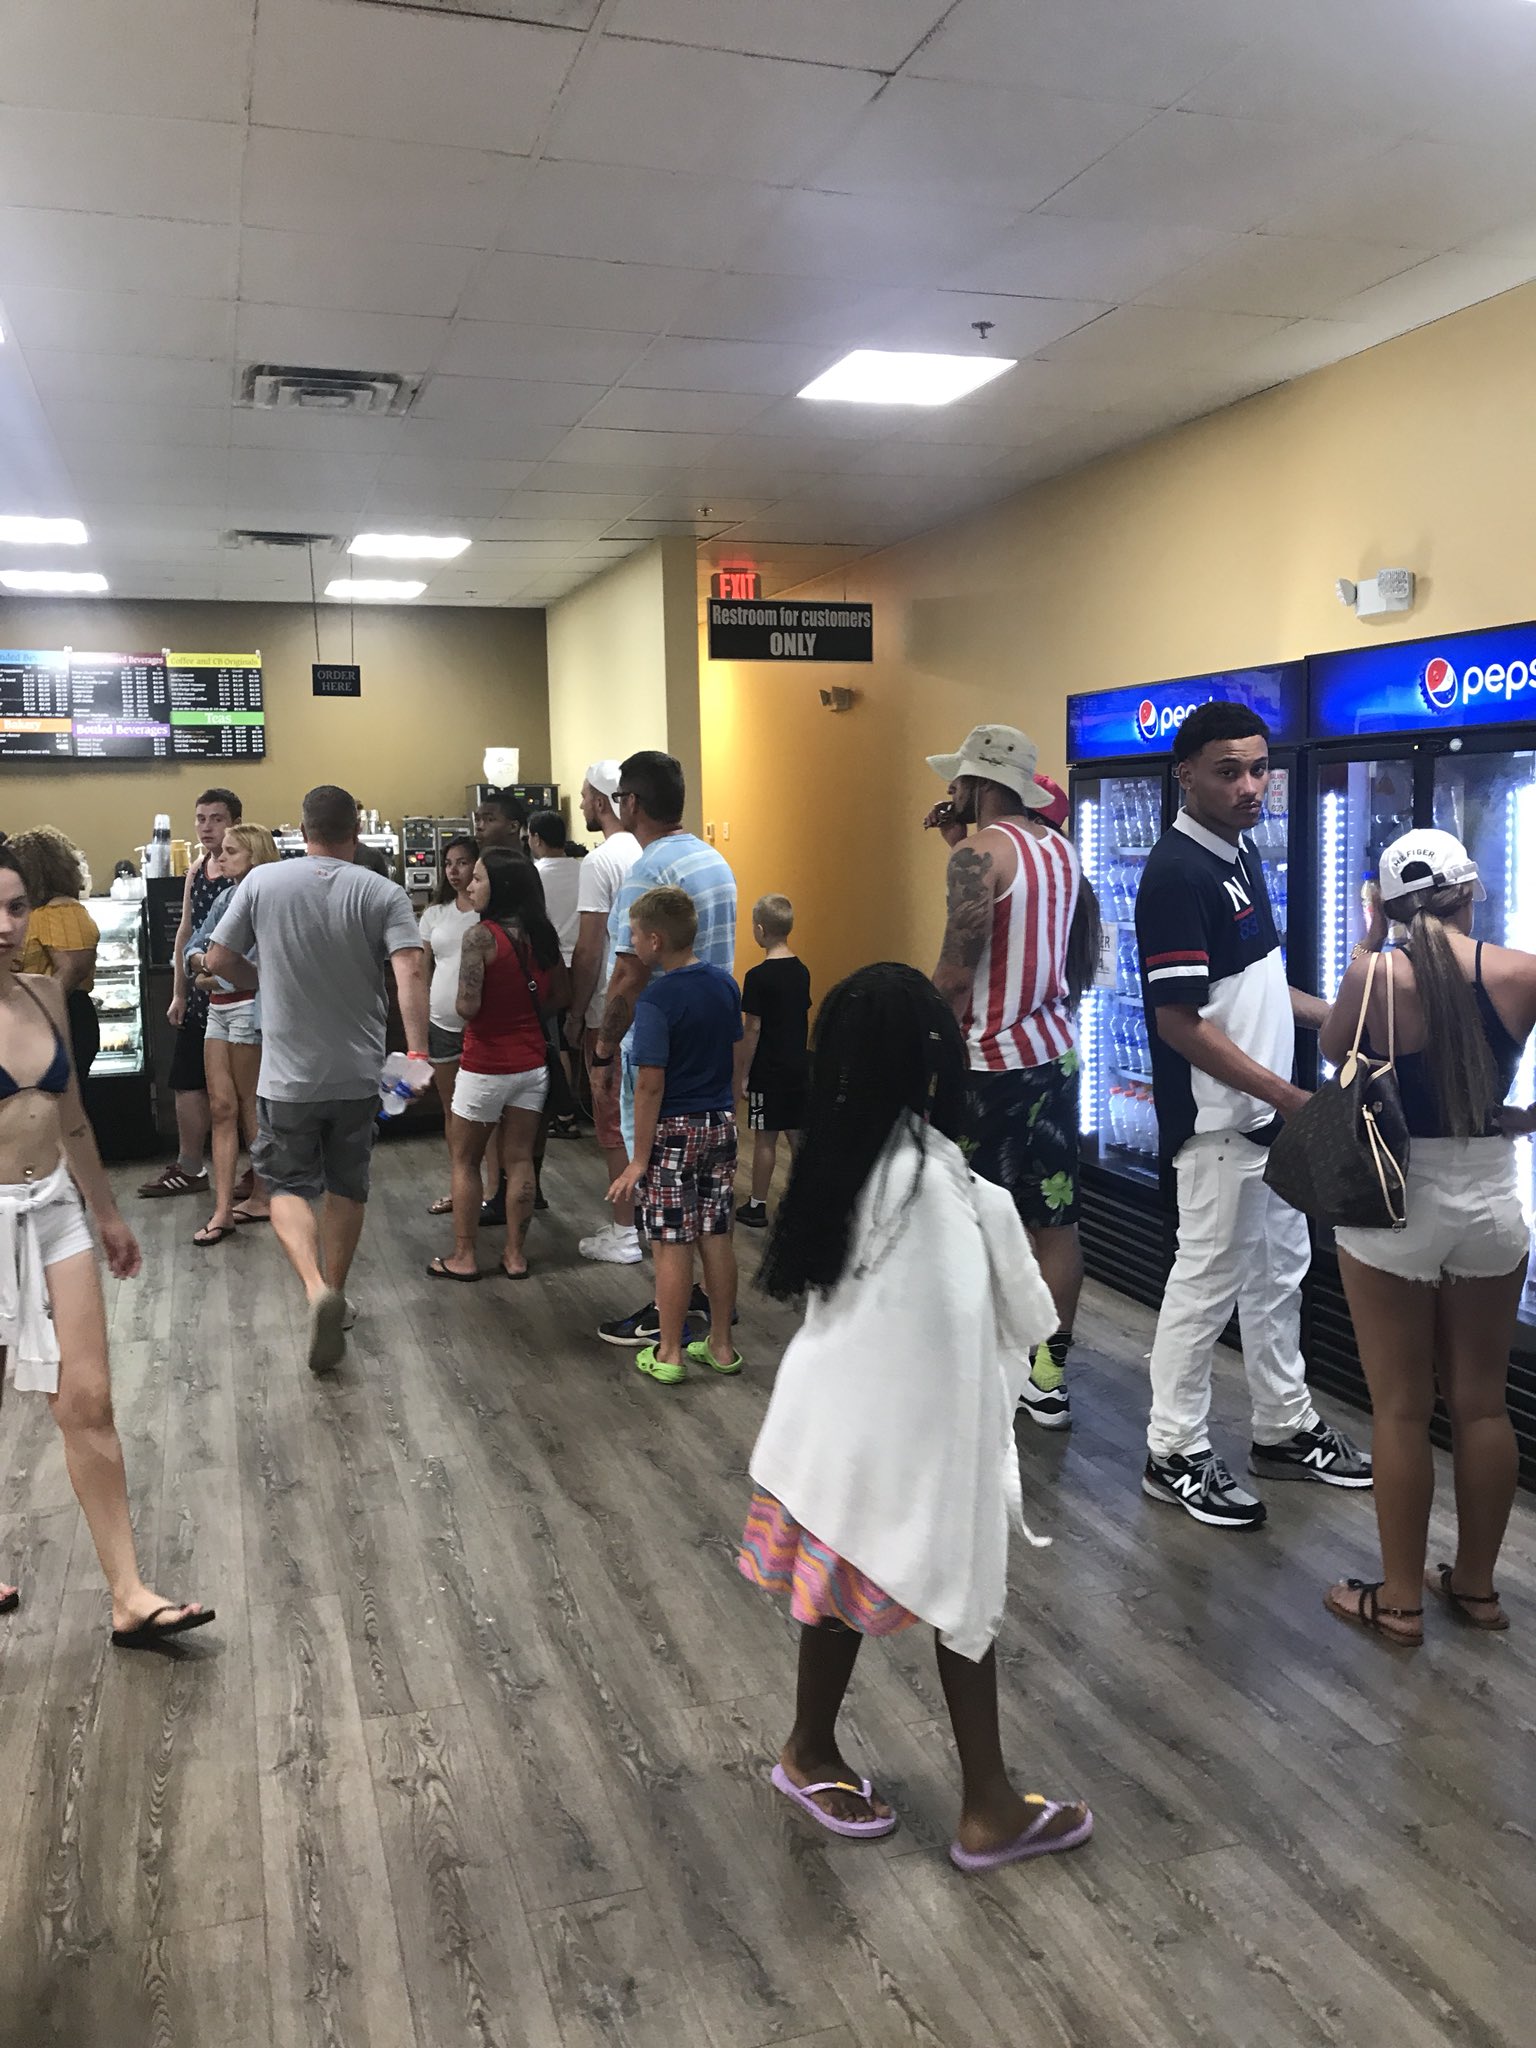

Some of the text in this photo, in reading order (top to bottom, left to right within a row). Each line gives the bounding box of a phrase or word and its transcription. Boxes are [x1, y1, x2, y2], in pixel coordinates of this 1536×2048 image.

[719, 574, 756, 599] EXIT
[712, 604, 871, 628] Restroom for customers
[769, 632, 817, 656] ONLY
[170, 656, 194, 665] Coffee
[197, 657, 211, 665] and
[224, 657, 258, 667] Originals
[317, 670, 356, 681] ORDER
[322, 681, 352, 692] HERE
[205, 712, 232, 724] Teas
[3, 719, 42, 732] Bakery
[76, 724, 168, 737] Bottled Beverages
[1223, 876, 1251, 912] N
